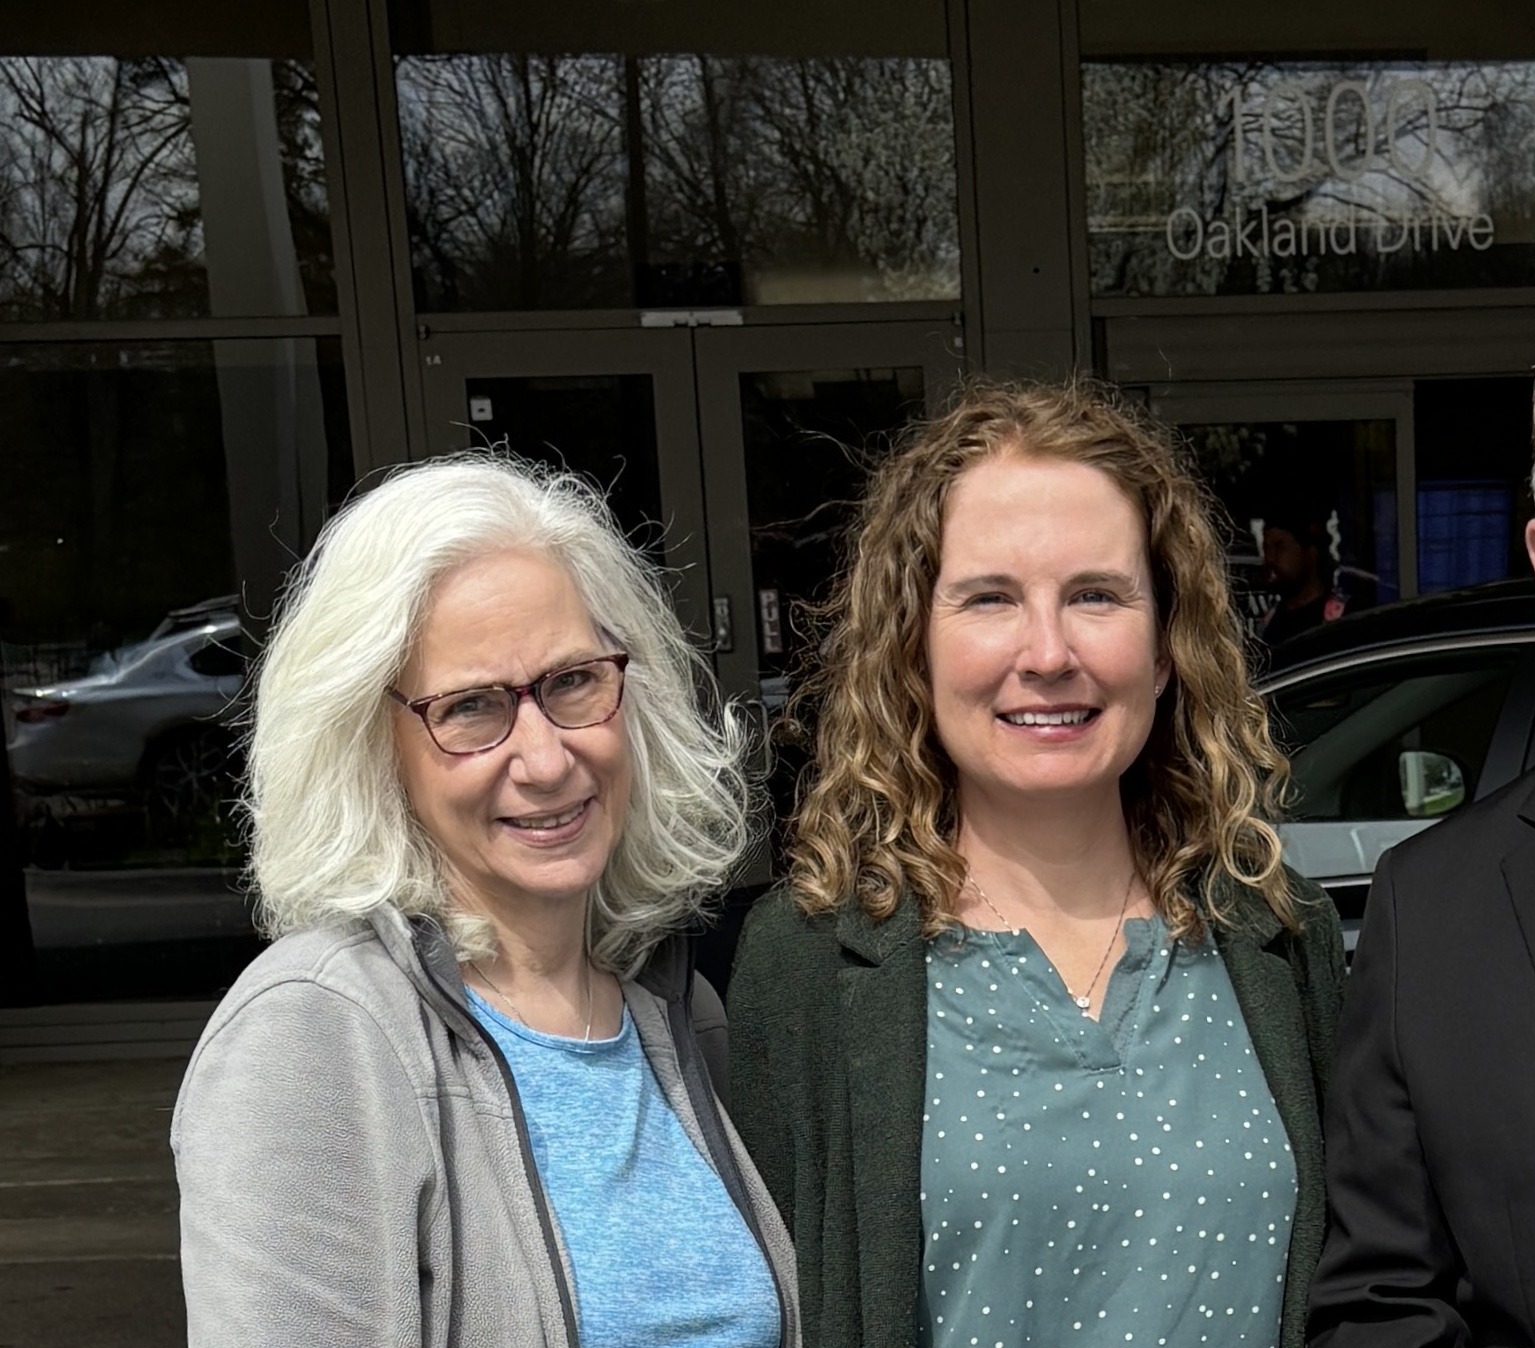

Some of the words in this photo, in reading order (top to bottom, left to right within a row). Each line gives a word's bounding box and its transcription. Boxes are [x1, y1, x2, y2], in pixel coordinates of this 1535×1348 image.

[1219, 81, 1437, 182] 1000
[1166, 206, 1357, 260] Oakland
[1377, 207, 1494, 253] Drive
